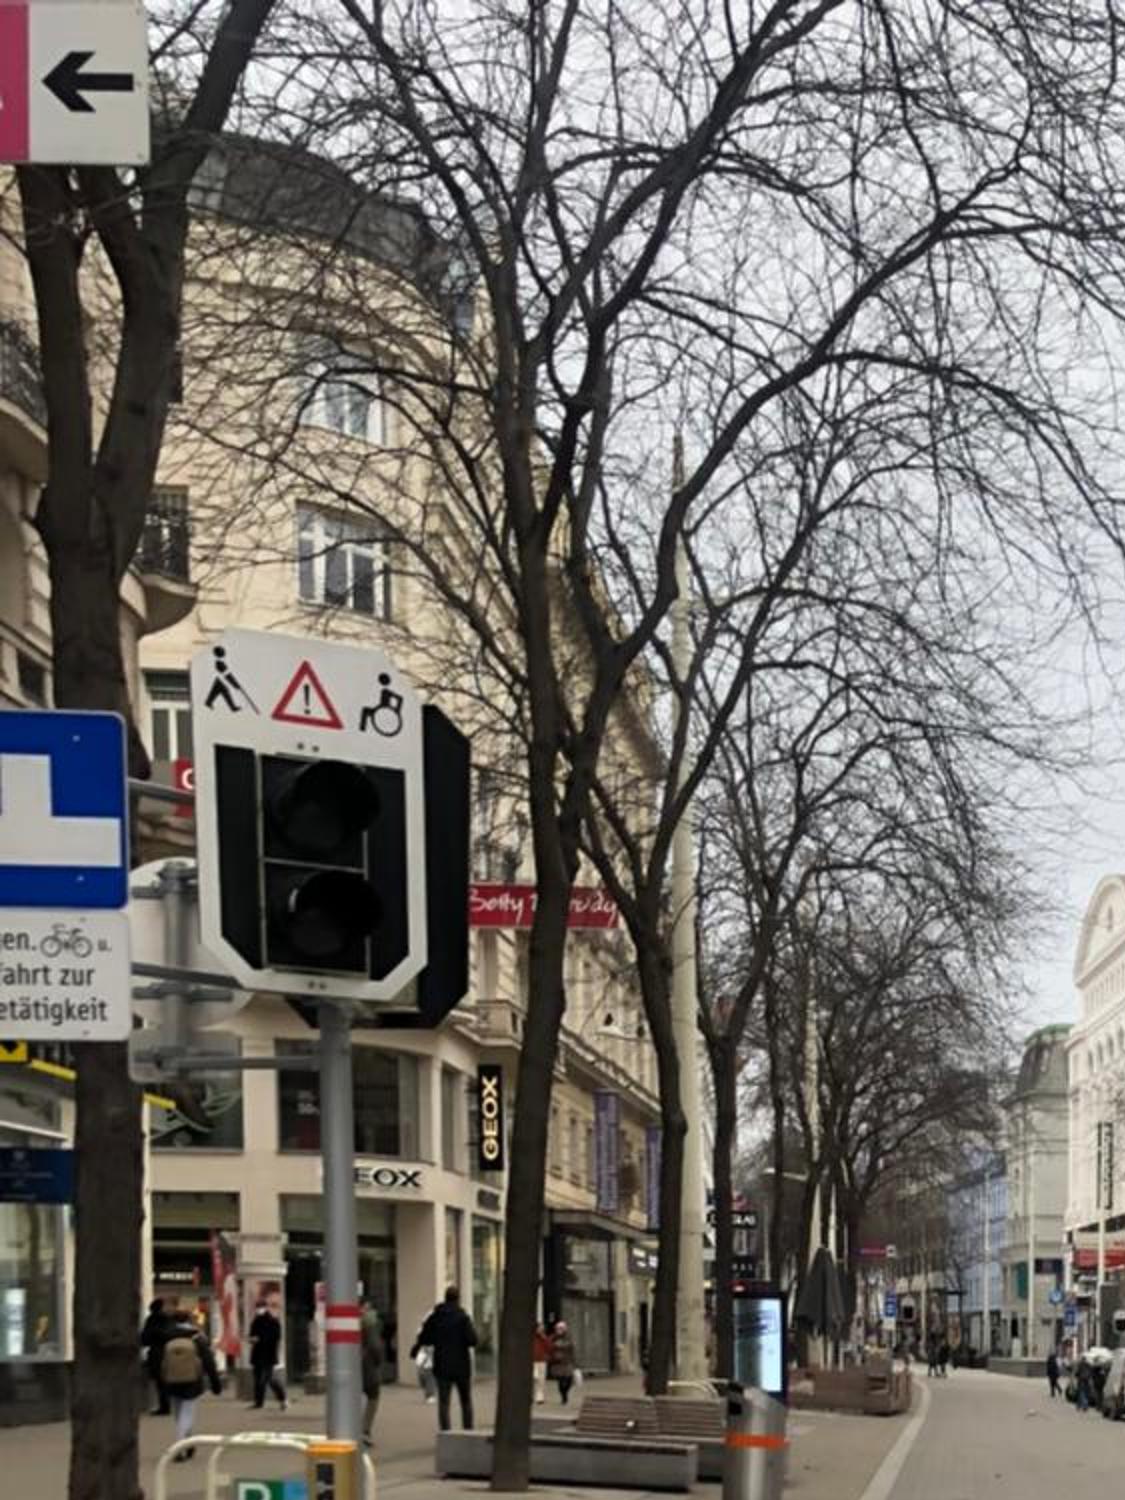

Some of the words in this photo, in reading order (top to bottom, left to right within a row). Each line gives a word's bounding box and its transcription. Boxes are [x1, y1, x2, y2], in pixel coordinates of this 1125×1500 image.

[0, 932, 37, 951] en.
[0, 962, 52, 987] ahrt
[60, 967, 95, 987] zur
[481, 1076, 499, 1161] GEOX
[354, 1167, 422, 1188] EOX
